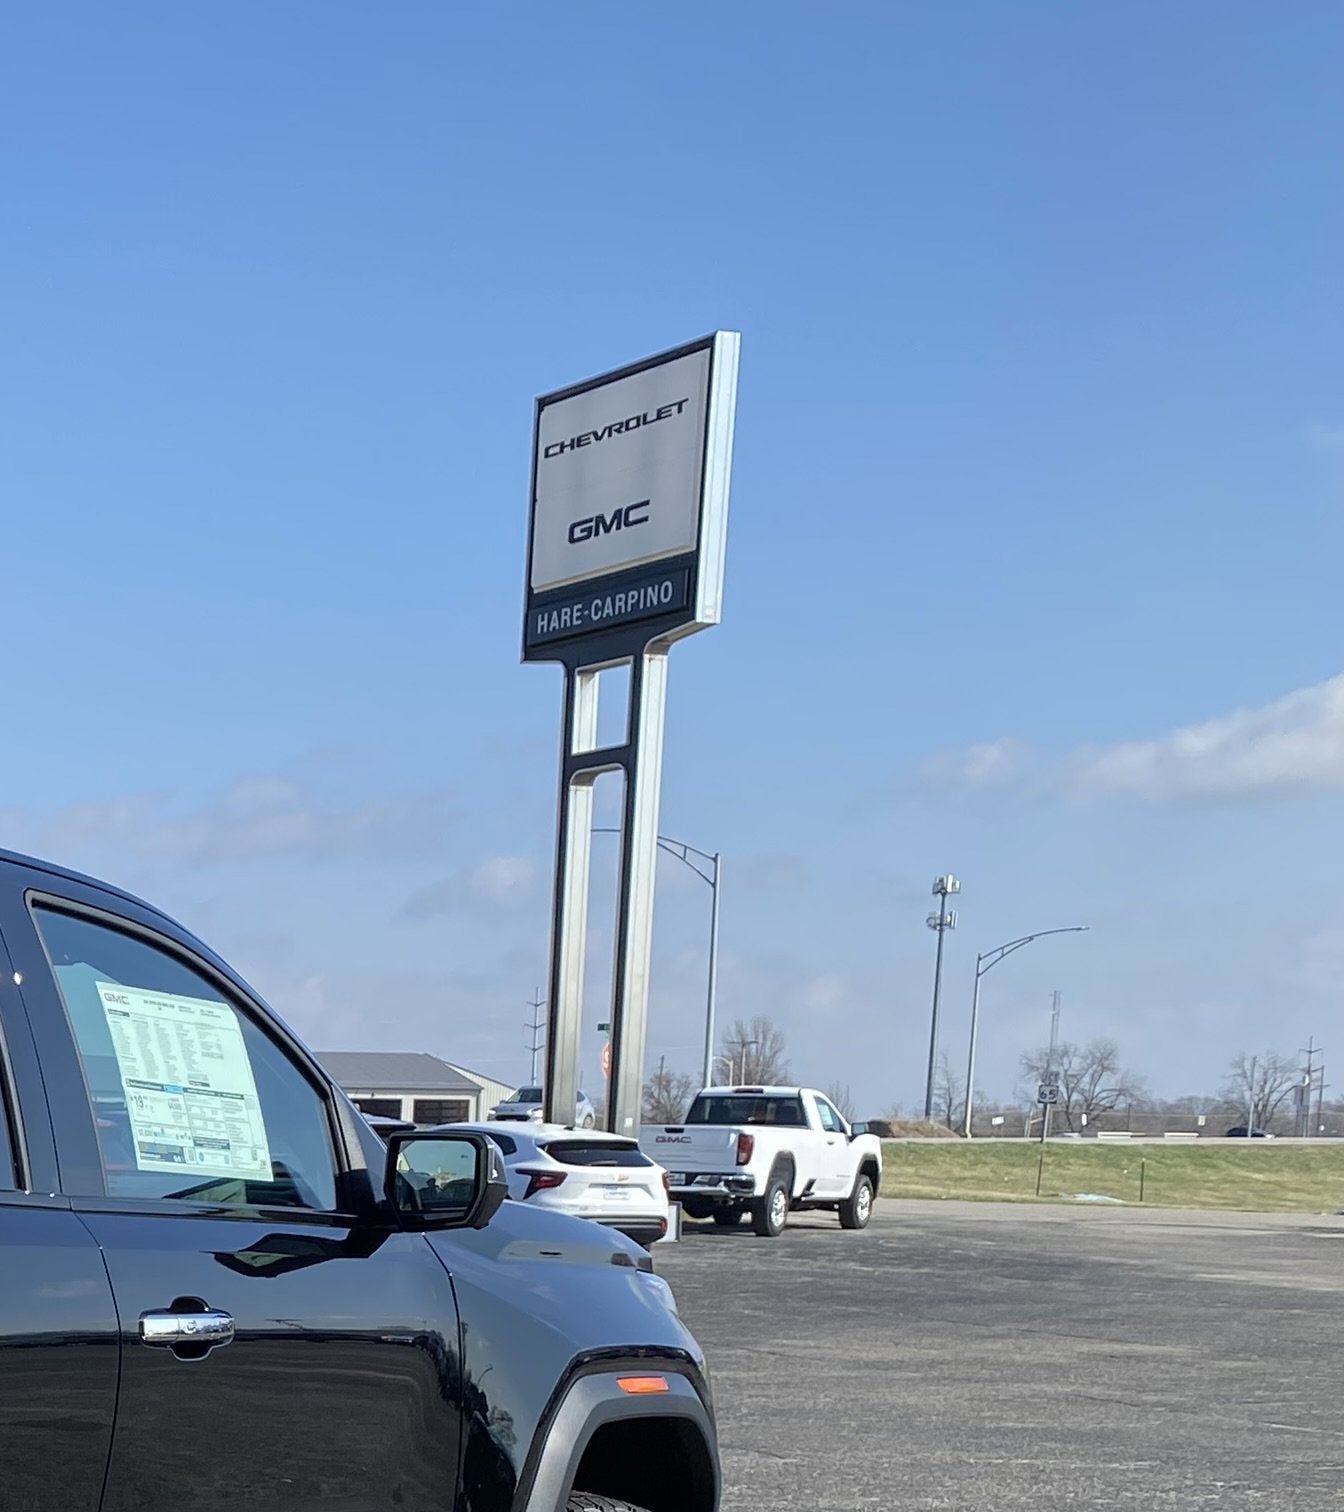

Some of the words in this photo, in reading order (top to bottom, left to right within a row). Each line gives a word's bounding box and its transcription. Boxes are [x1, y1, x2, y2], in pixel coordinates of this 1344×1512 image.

[544, 398, 689, 459] CHEVROLET
[568, 499, 650, 544] GMC
[537, 580, 674, 634] HARE-CARPINO
[104, 992, 130, 1006] GMC
[1040, 1089, 1056, 1100] 65
[656, 1136, 692, 1144] GMC
